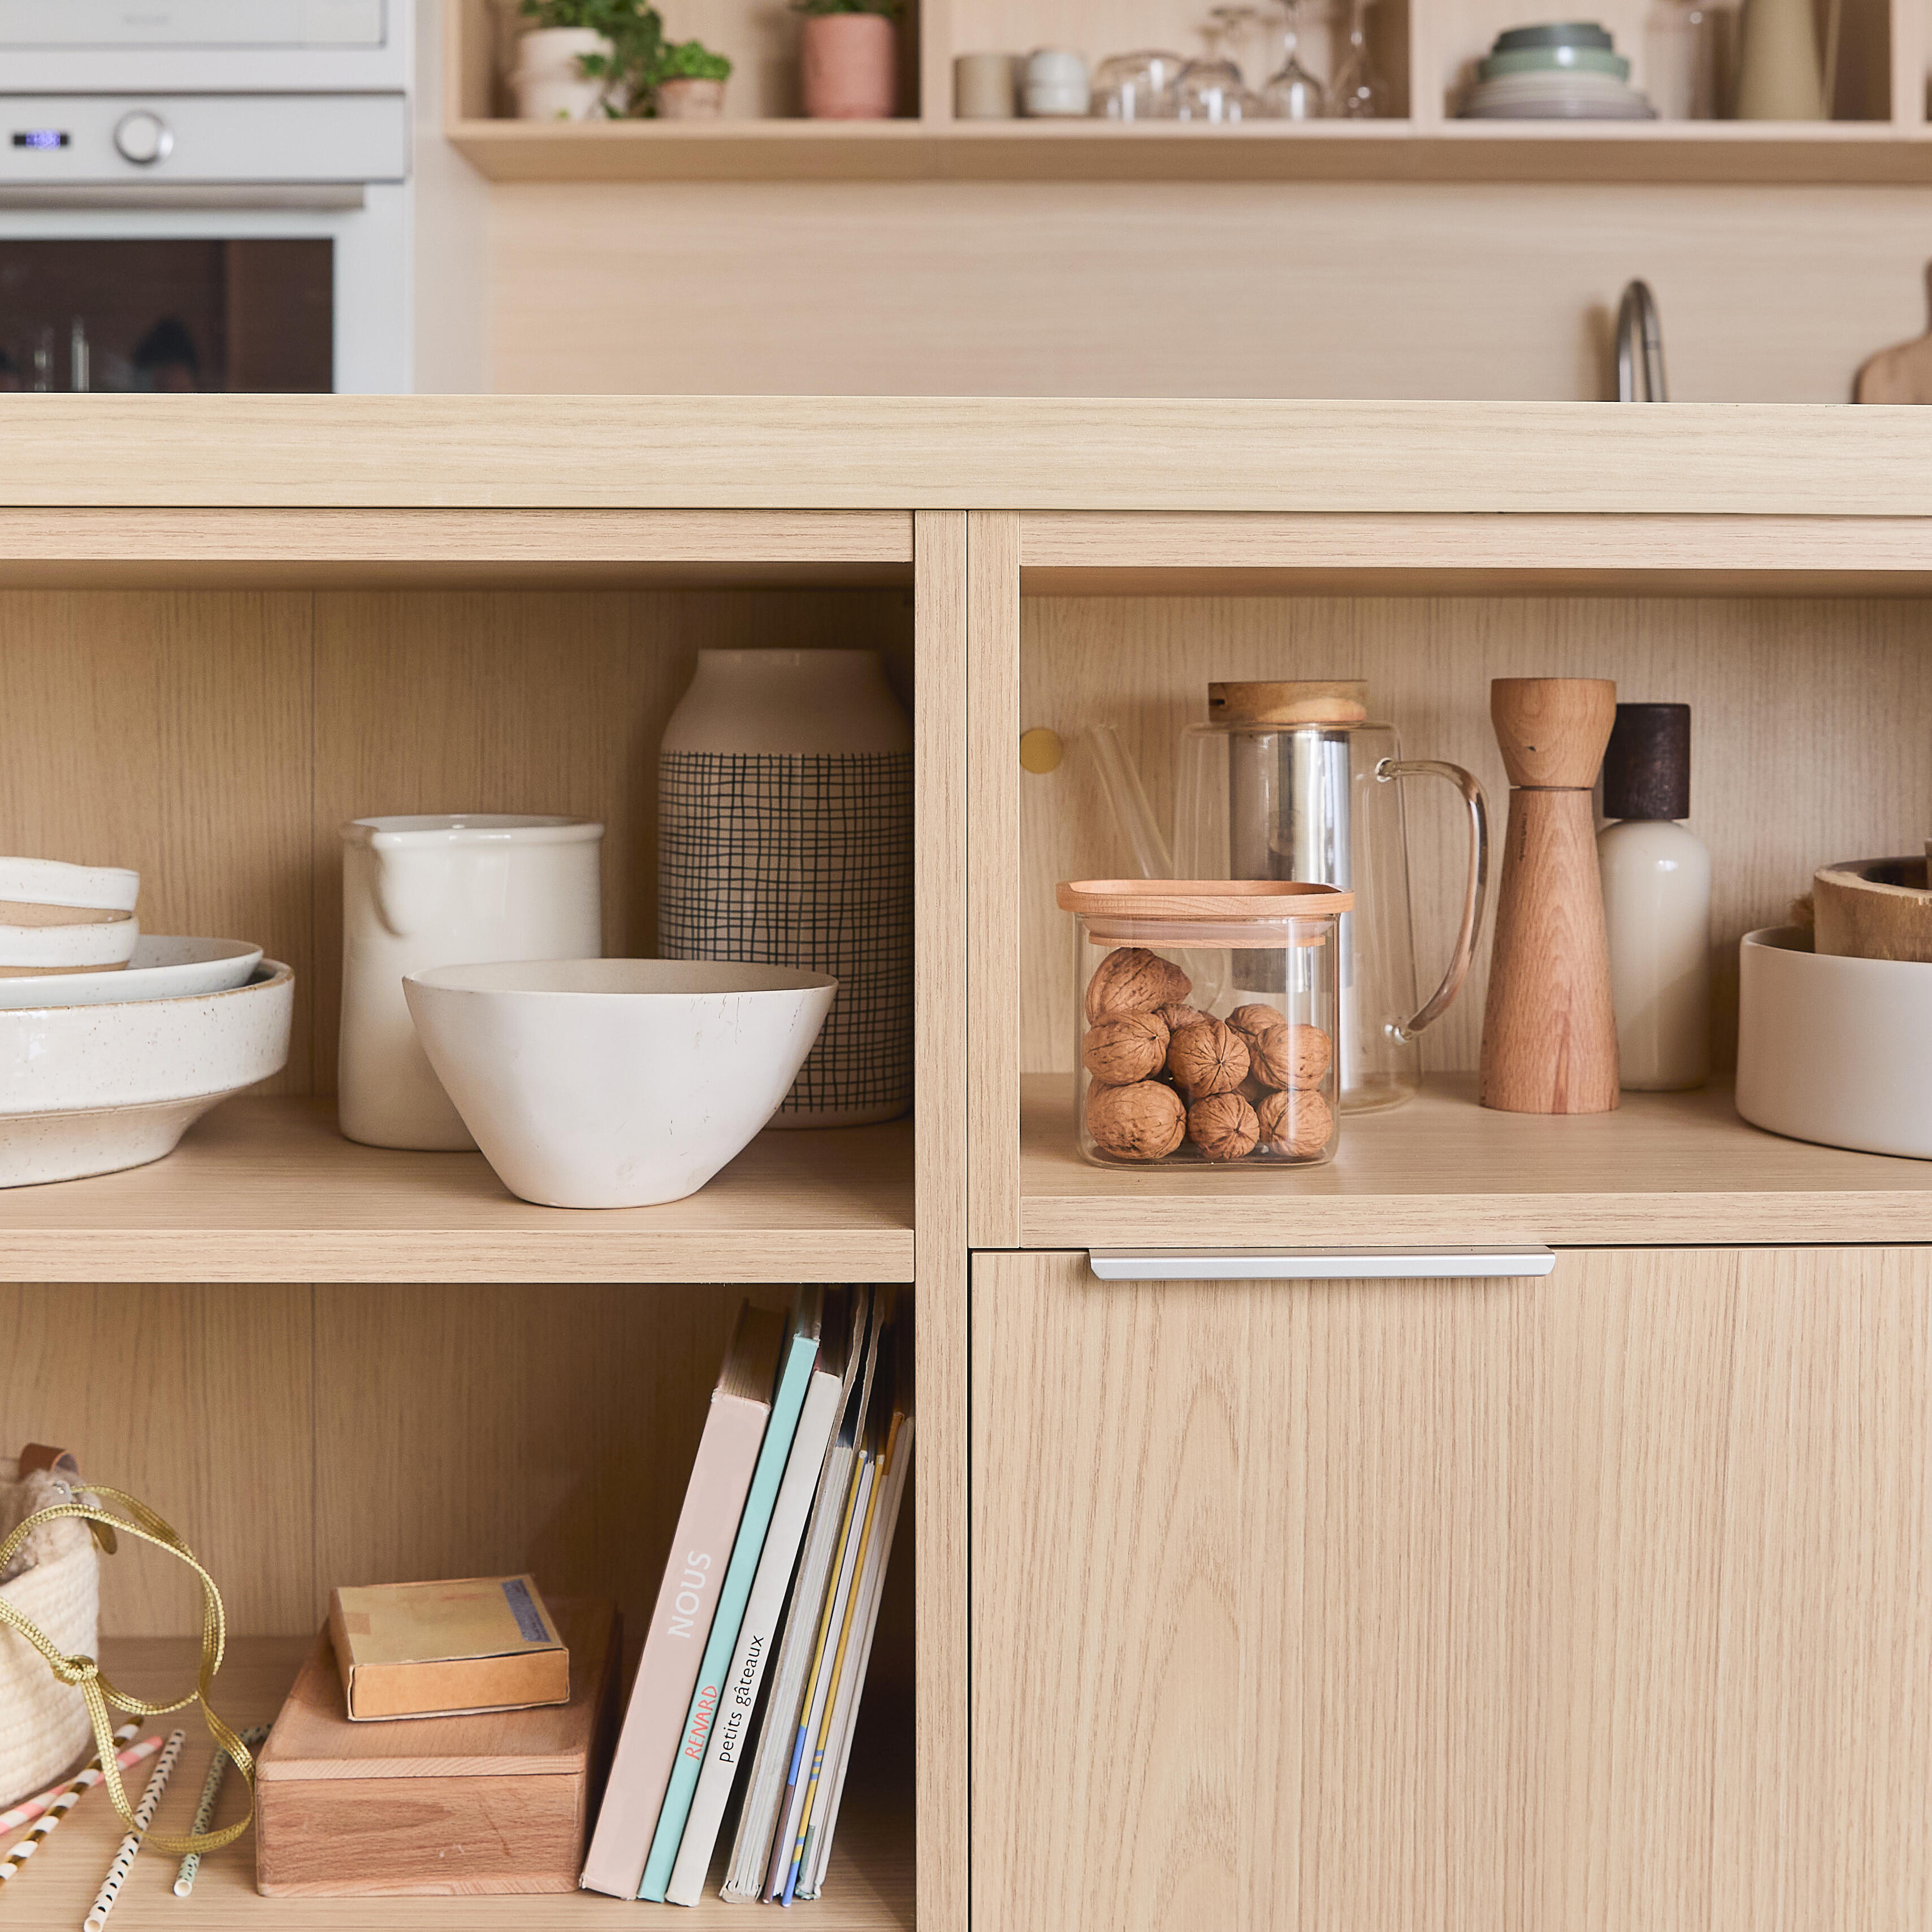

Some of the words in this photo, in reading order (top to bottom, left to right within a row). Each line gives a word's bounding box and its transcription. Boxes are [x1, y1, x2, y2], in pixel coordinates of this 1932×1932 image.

[668, 1550, 712, 1638] NOUS
[685, 1686, 717, 1761] RENARD
[719, 1712, 742, 1763] petits
[734, 1635, 764, 1706] gâteaux
